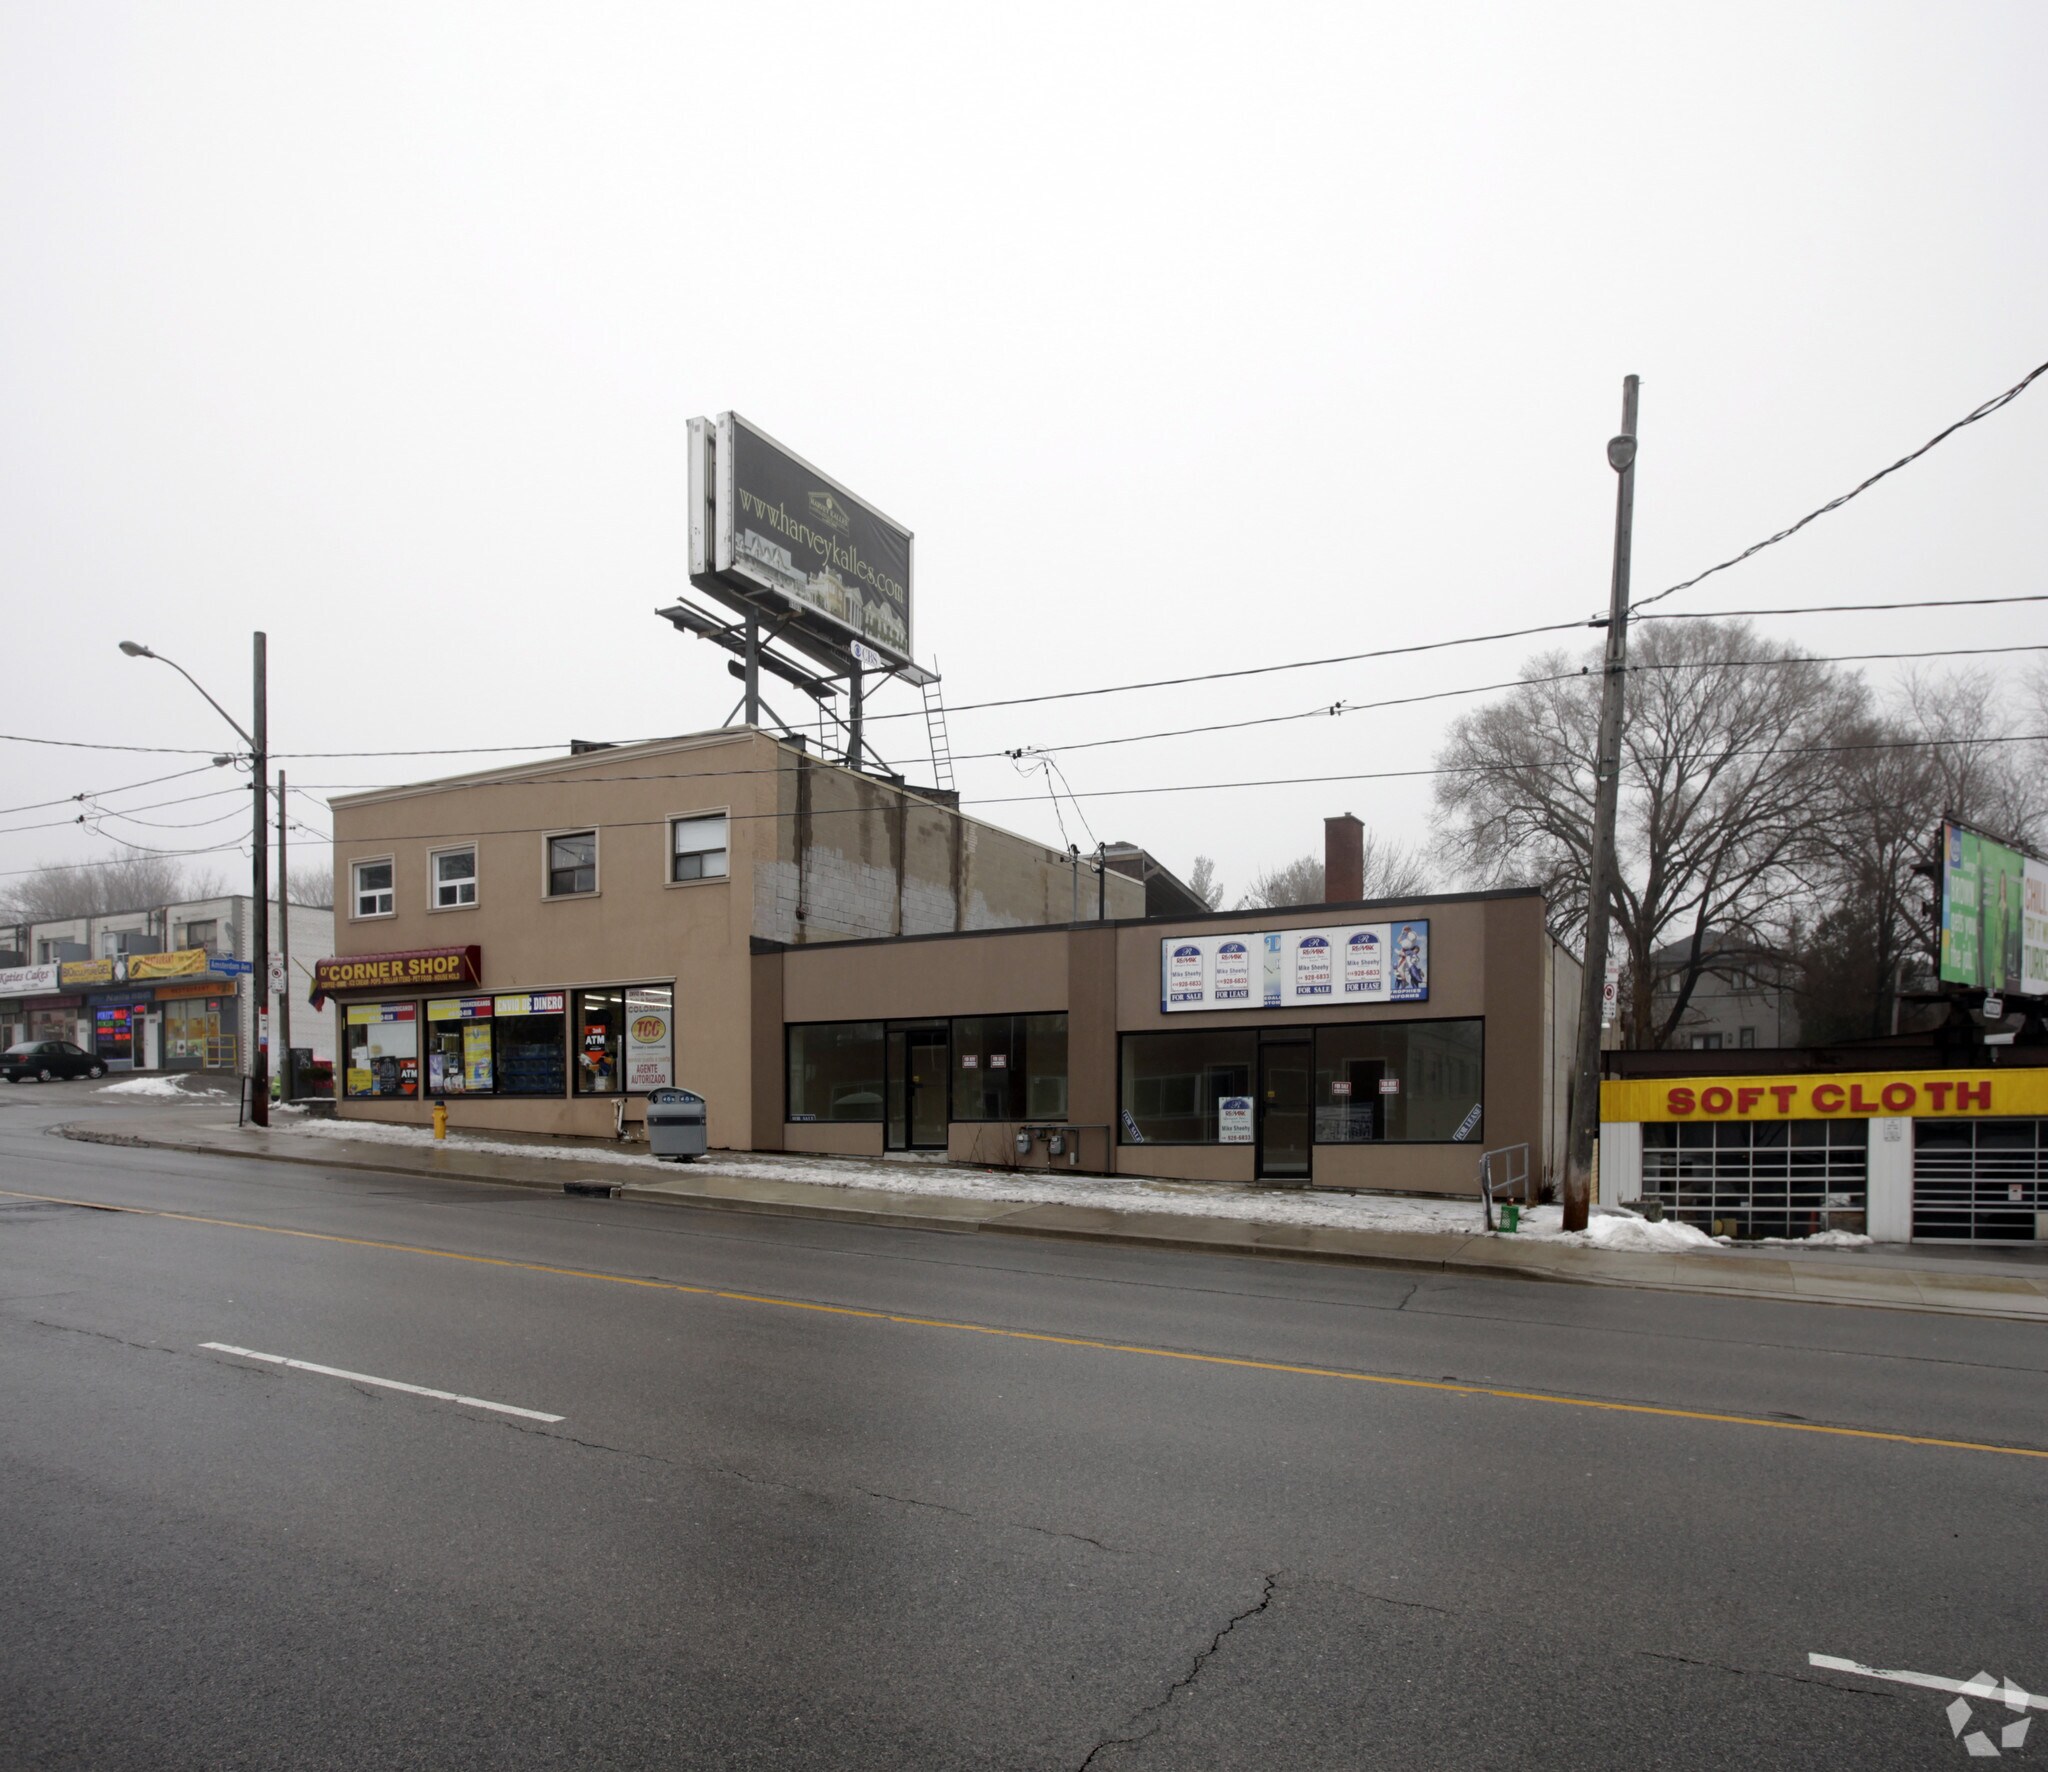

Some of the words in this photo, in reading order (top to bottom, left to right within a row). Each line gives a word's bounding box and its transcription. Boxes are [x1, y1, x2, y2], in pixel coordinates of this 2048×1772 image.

[738, 487, 904, 604] www.harveykalles.com
[862, 647, 878, 666] CBS
[210, 960, 240, 971] Amsterdam
[408, 955, 460, 976] SHOP
[1360, 960, 1380, 968] Sheehy
[0, 972, 24, 985] Katies
[25, 967, 50, 983] Cakes
[1229, 968, 1247, 976] Sheehy
[1354, 969, 1380, 977] 928-6833
[1178, 980, 1202, 988] 928-6833
[1223, 977, 1247, 985] 928-6833
[1346, 983, 1359, 991] FOR
[1360, 982, 1381, 990] LEASE
[1229, 990, 1248, 998] LEASE
[1297, 986, 1311, 994] FOR
[1313, 985, 1331, 993] SALE
[1171, 993, 1184, 1001] FOR
[1186, 992, 1202, 1000] SALE
[497, 998, 521, 1011] ENVIO
[521, 997, 532, 1010] DE
[533, 996, 563, 1010] DINERO
[636, 1020, 661, 1038] TCC
[585, 1034, 606, 1045] ATM
[401, 1069, 418, 1079] ATM
[636, 1064, 658, 1074] AGENTE
[631, 1074, 666, 1085] AUTORIZADO
[1666, 1085, 1798, 1115] SOFT
[1811, 1081, 1992, 1113] CLOTH
[1122, 1111, 1132, 1126] FOR
[1131, 1126, 1142, 1143] SALE
[1456, 1126, 1468, 1140] FOR
[1465, 1106, 1481, 1128] LEASE
